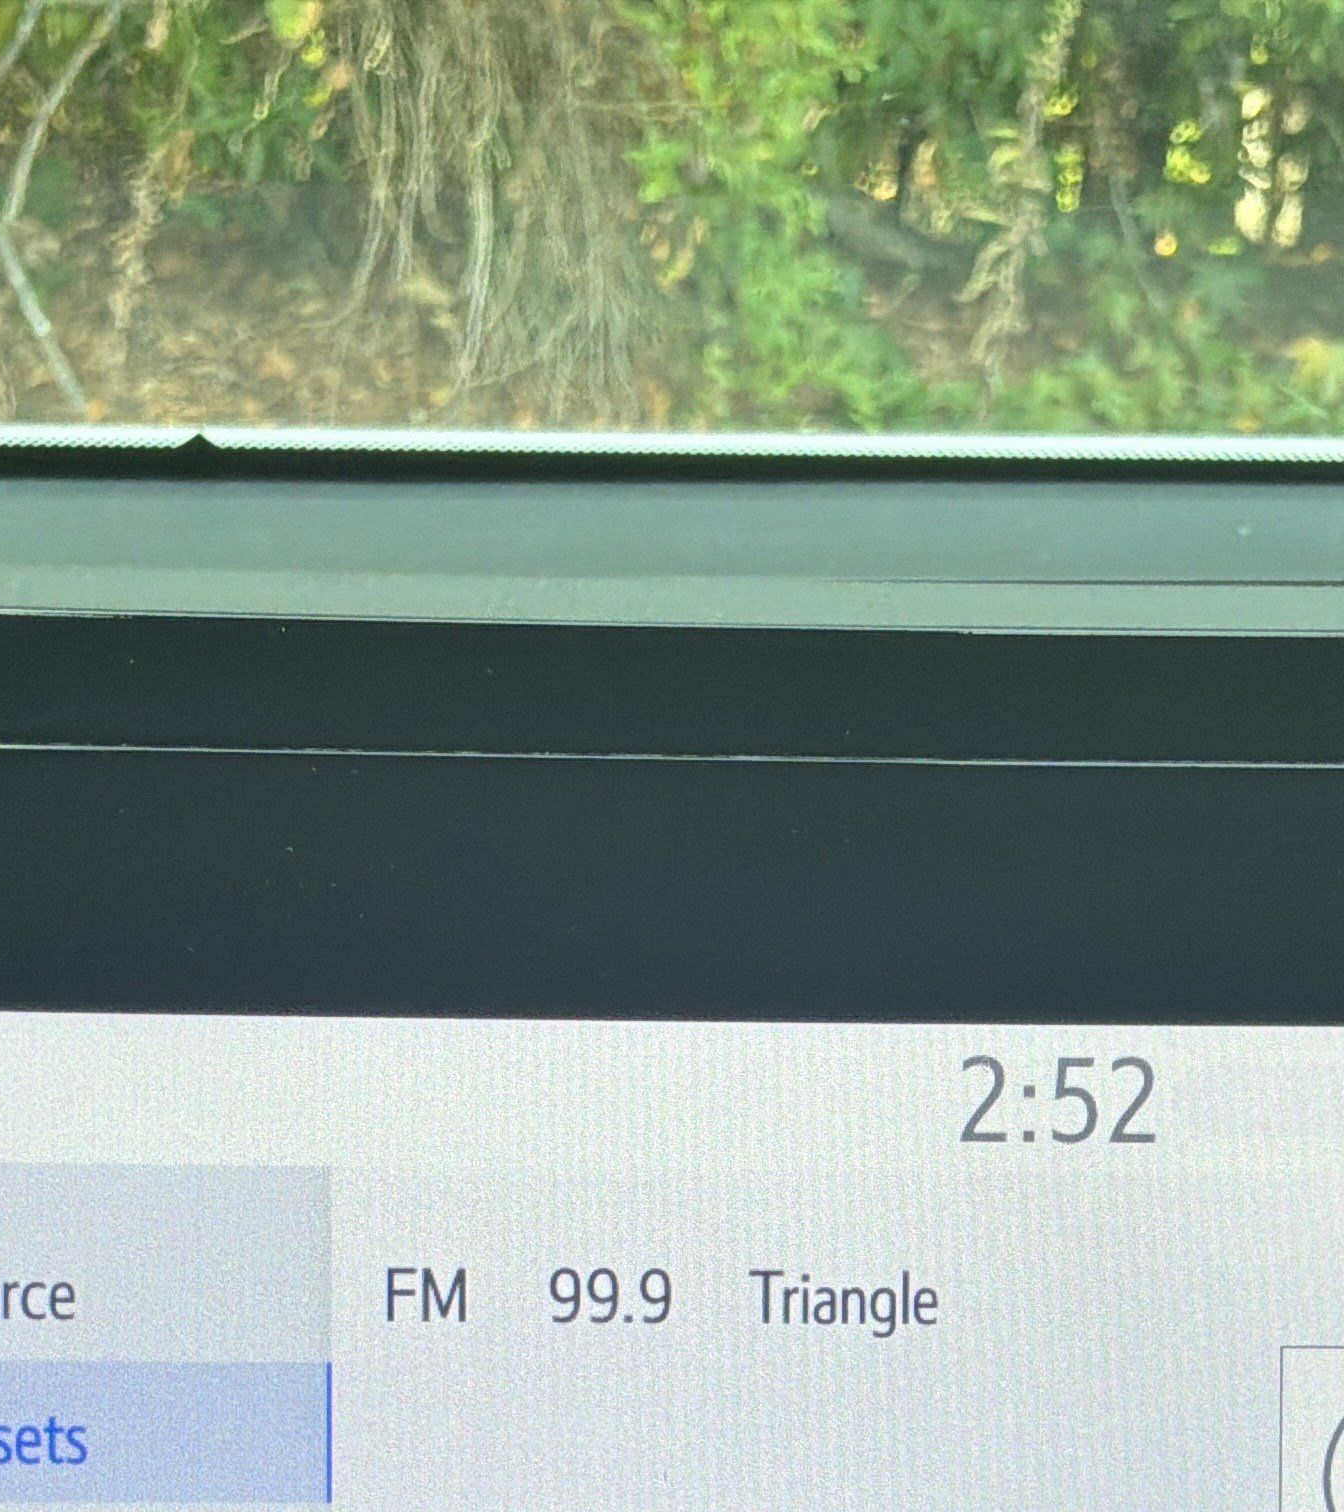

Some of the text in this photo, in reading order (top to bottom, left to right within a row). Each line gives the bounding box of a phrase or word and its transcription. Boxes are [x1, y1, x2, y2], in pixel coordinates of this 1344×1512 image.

[961, 1056, 1155, 1144] 2:52
[387, 1268, 938, 1338] FM 99.9 Triangle
